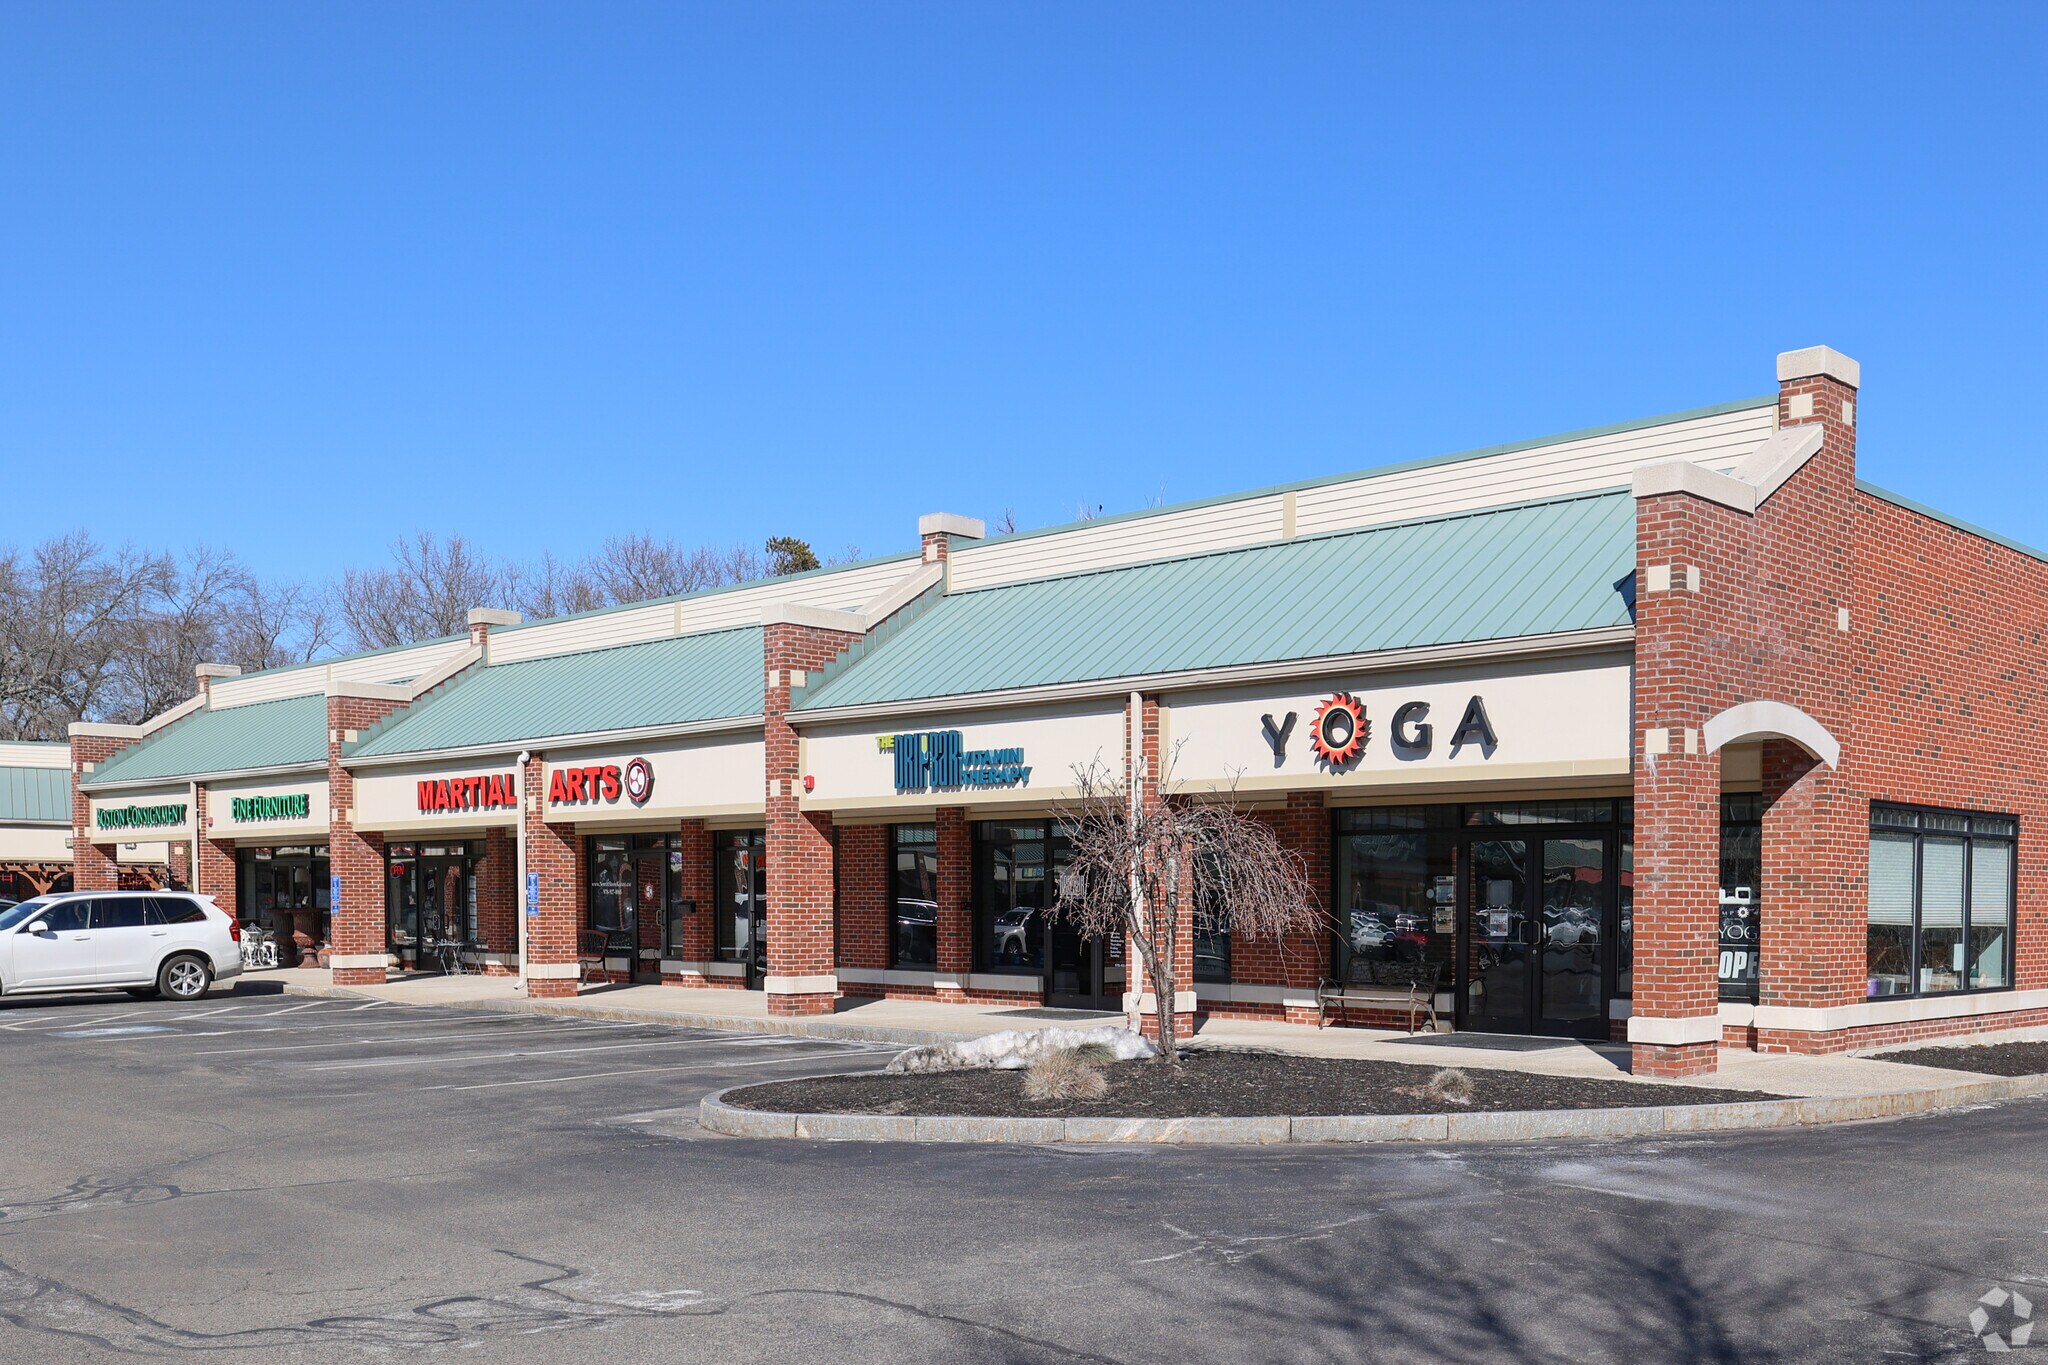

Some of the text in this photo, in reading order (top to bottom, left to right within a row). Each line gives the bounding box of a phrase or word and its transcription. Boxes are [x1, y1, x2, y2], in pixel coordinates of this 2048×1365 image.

[1261, 692, 1497, 764] YOGA
[876, 736, 895, 749] THE
[961, 748, 1024, 766] VITAMIN
[960, 766, 1032, 786] THERAPY
[417, 765, 621, 810] MARTIAL ARTS
[97, 804, 184, 827] BOSTON CONSIGNMENT
[231, 794, 306, 819] FINE FURNITURE
[391, 865, 404, 875] OPEN
